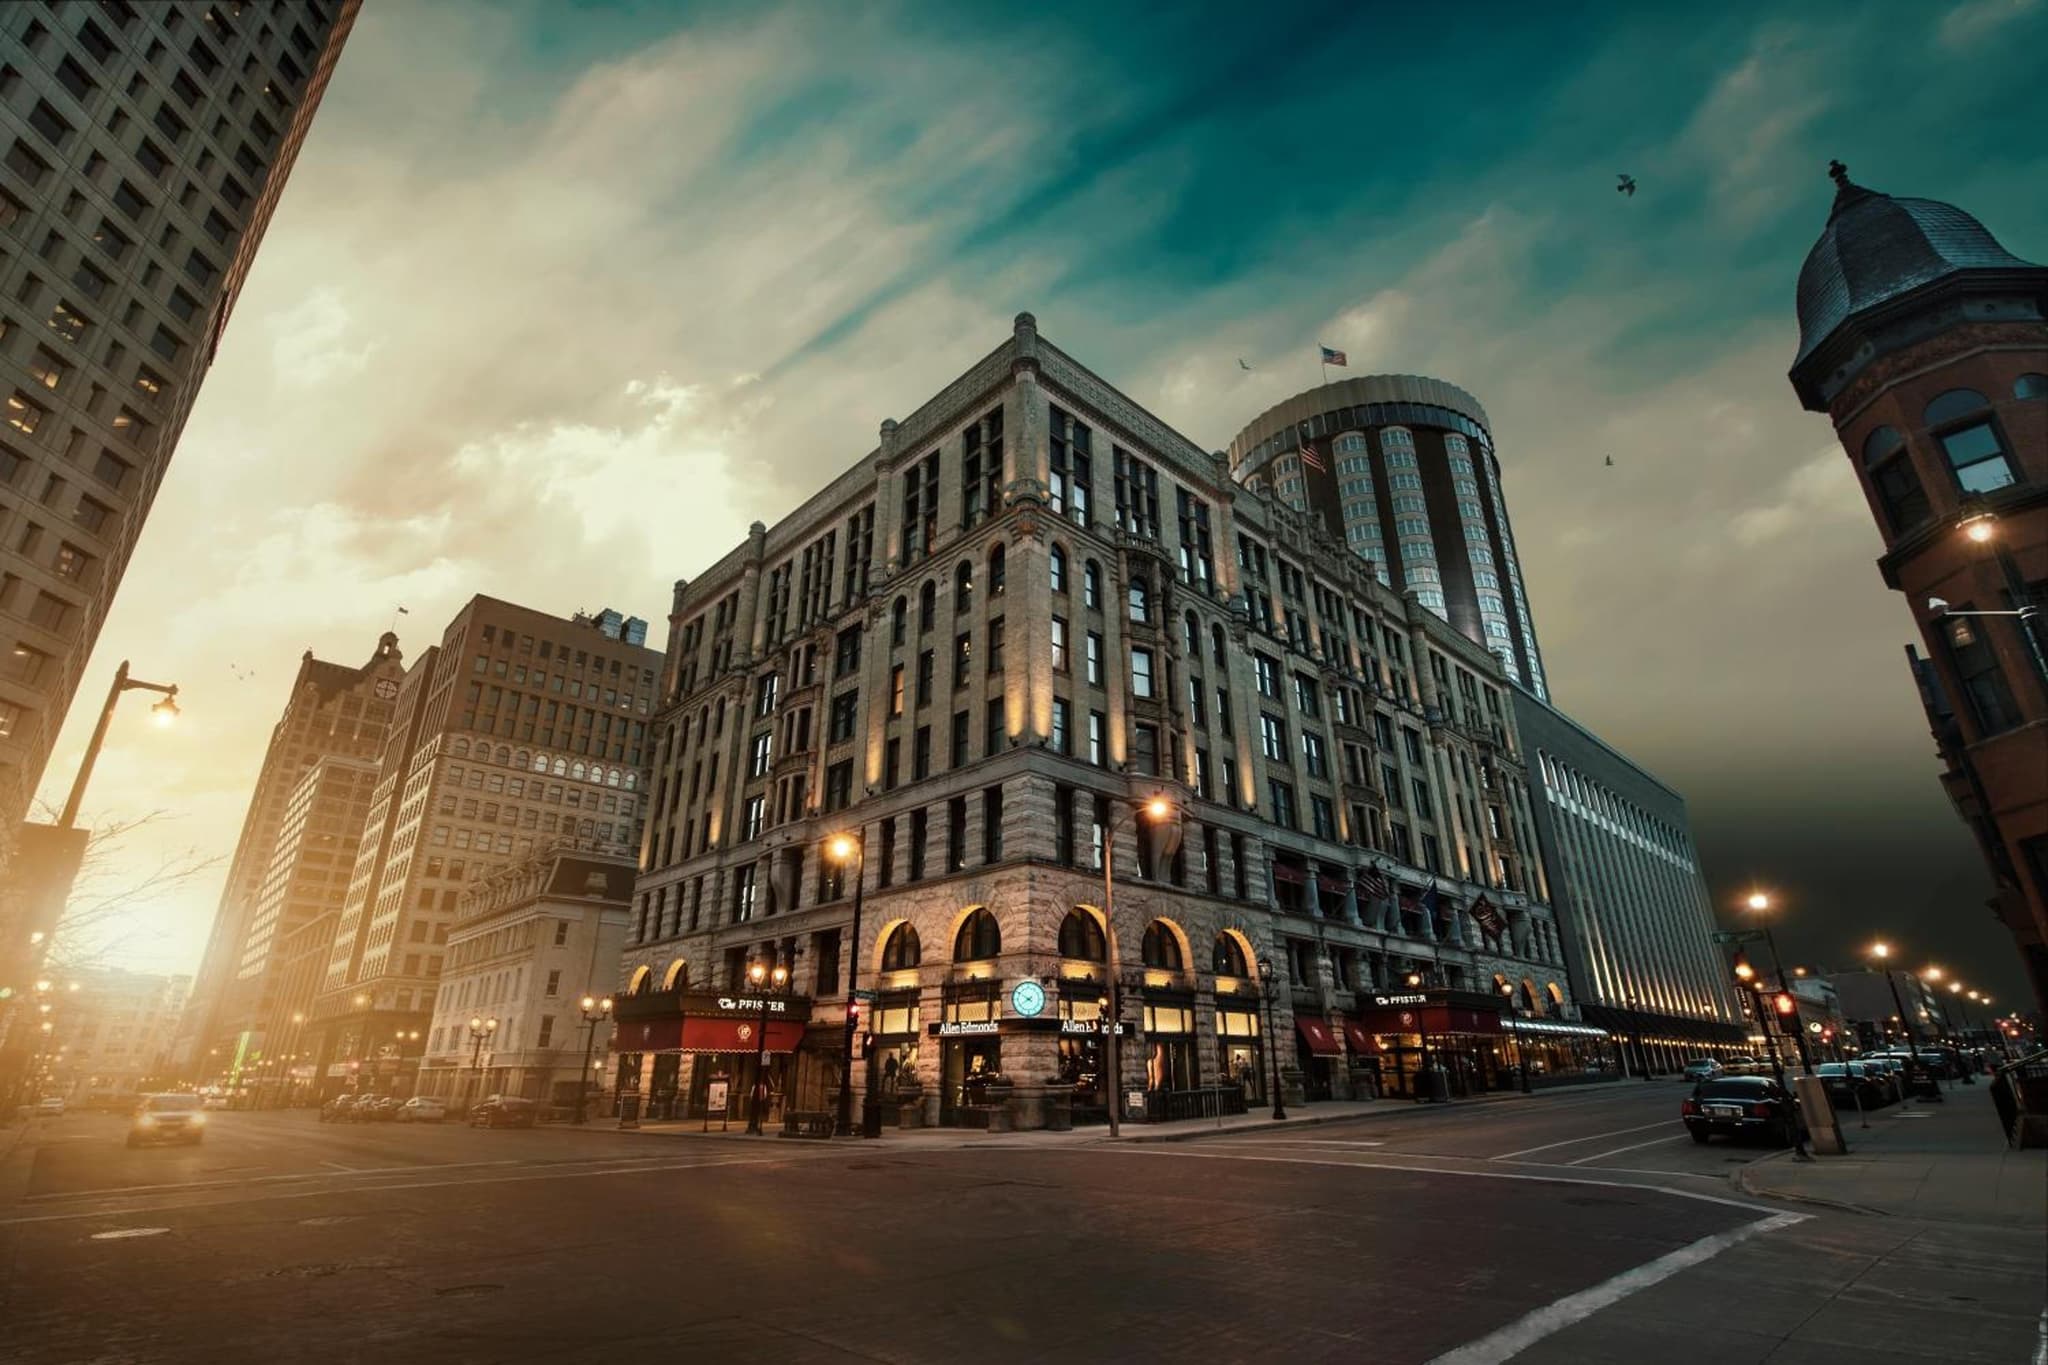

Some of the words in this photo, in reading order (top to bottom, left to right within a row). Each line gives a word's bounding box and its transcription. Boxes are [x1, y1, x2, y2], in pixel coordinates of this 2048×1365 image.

[738, 999, 785, 1012] PFISER
[940, 1022, 960, 1034] Allen
[961, 1020, 999, 1034] Edmonds
[1061, 1020, 1085, 1033] Allen
